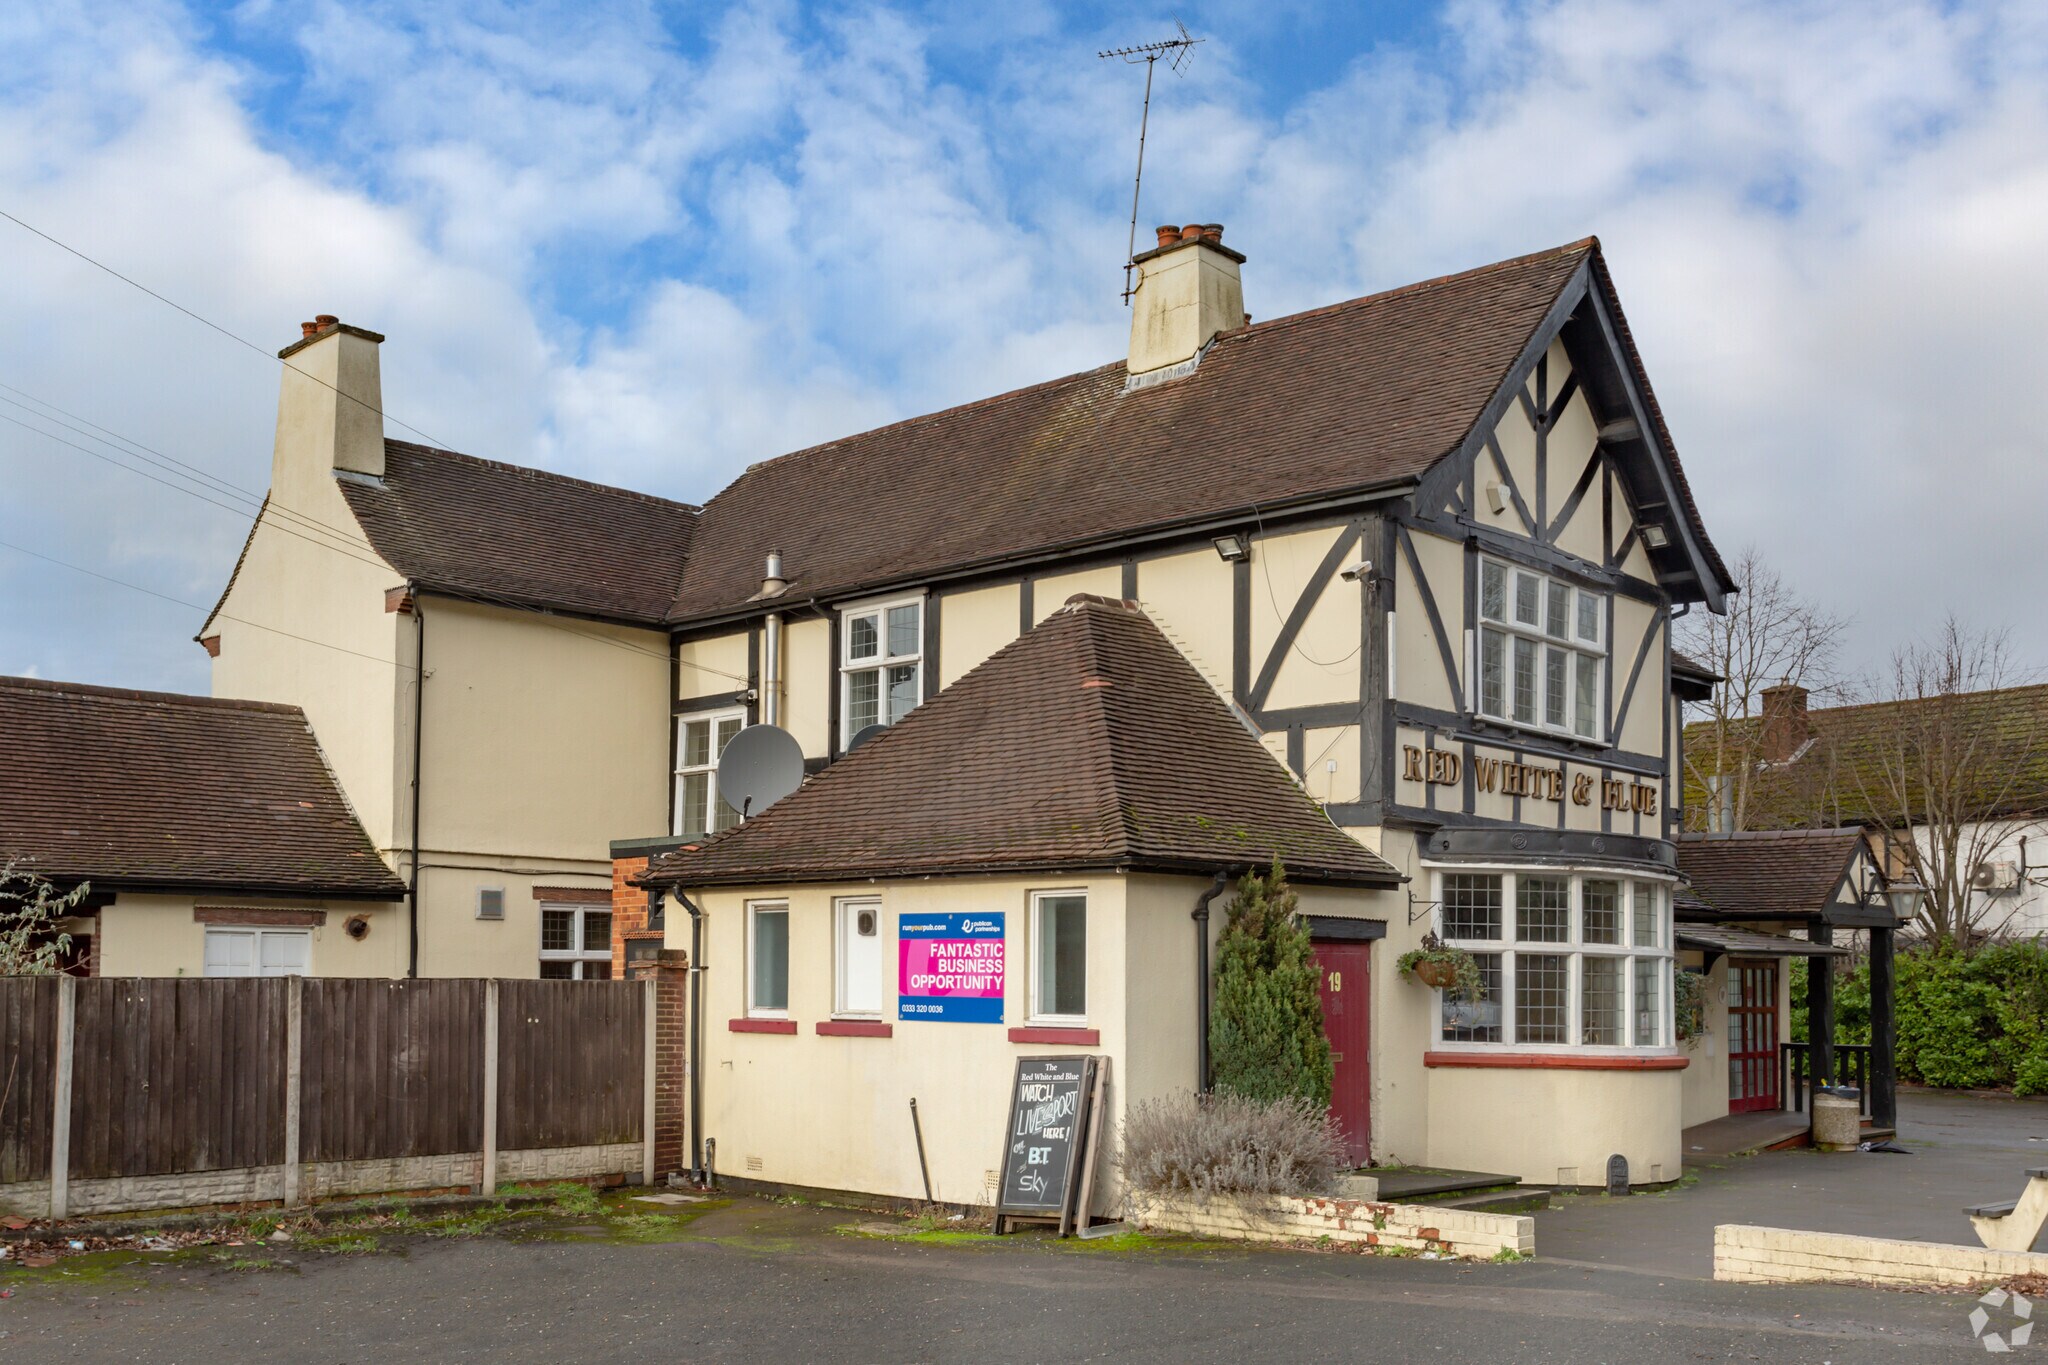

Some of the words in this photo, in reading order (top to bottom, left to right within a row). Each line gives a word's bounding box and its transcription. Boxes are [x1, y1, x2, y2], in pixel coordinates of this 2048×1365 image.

[1403, 744, 1462, 786] RED
[1474, 755, 1564, 802] WHITE
[1572, 772, 1594, 806] &
[1601, 778, 1657, 816] BLUE
[902, 924, 946, 932] runyourpub.com
[930, 943, 1003, 957] FANTASTIC
[938, 959, 1003, 973] BUSINESS
[911, 975, 1003, 990] OPPORTUNITY
[1328, 972, 1341, 992] 19
[901, 1004, 915, 1012] 0333
[916, 1004, 927, 1013] 320
[1045, 1063, 1058, 1071] The
[1021, 1073, 1033, 1081] Red
[1034, 1073, 1052, 1081] White
[1065, 1072, 1079, 1080] Blue
[1021, 1083, 1055, 1102] WATCH
[1017, 1106, 1044, 1136] LIVE
[1042, 1090, 1078, 1126] SPORT
